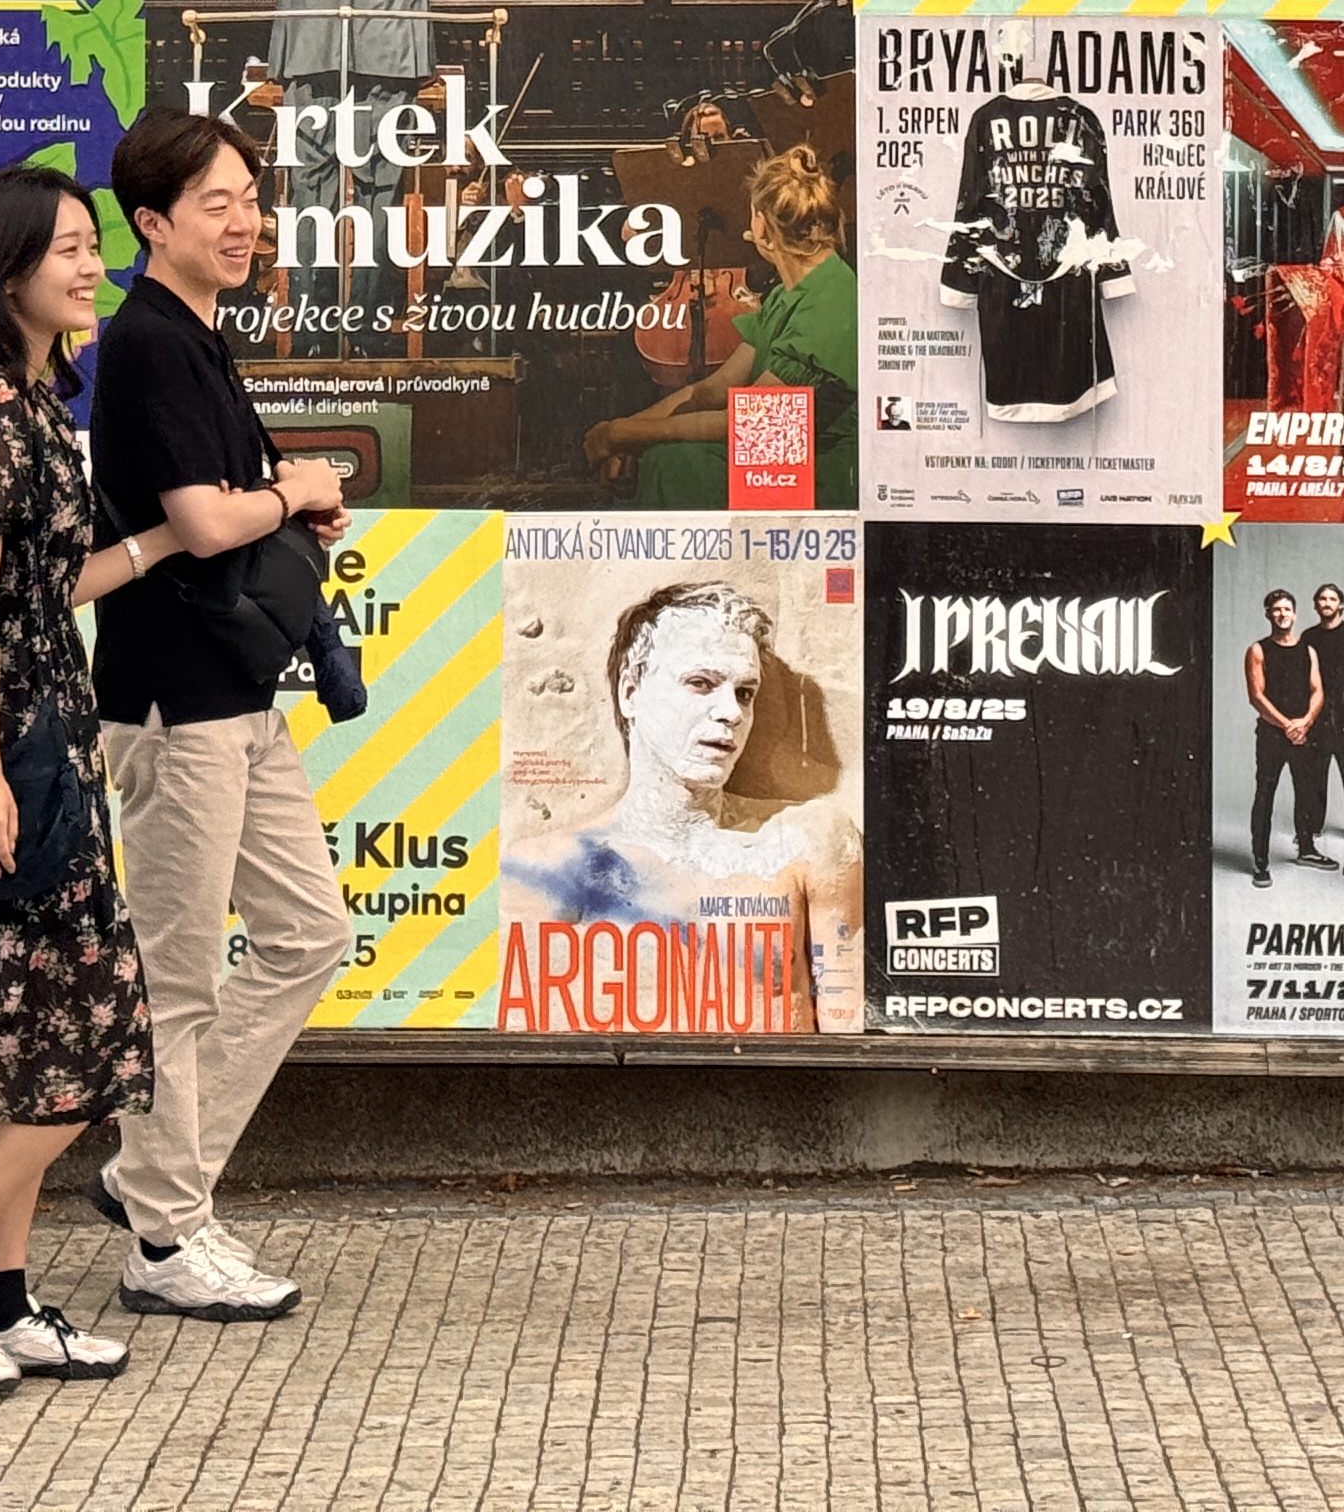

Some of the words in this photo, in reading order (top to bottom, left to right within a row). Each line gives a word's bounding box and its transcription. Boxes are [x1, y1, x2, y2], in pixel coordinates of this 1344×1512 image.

[1046, 29, 1206, 94] ADAMS
[30, 115, 90, 132] rodinu
[876, 107, 891, 135] 1.
[898, 107, 959, 135] SRPEN
[1112, 109, 1162, 137] PARK
[1168, 110, 1205, 137] 360
[876, 141, 924, 169] 2025
[1134, 173, 1206, 202] KRÁLOVÉ
[272, 174, 690, 270] muzika
[214, 294, 364, 345] rojekce
[372, 302, 395, 332] s
[405, 294, 515, 334] živou
[527, 292, 688, 334] hudbou
[745, 470, 798, 487] fok.cz
[504, 523, 584, 561] ANTICKÁ
[589, 519, 676, 561] ŠTVANICE
[681, 527, 733, 561] 2025
[887, 698, 1026, 720] 19/8/25
[355, 822, 469, 869] Klus
[342, 882, 465, 923] kupina
[700, 896, 733, 917] MARIE
[735, 893, 791, 917] NOVÁKOVÁ
[896, 906, 989, 939] RFP
[893, 948, 994, 971] CONCERTS
[497, 920, 792, 1033] ARGONAUTI
[886, 996, 1183, 1020] RFPCONCERTS.CZ
